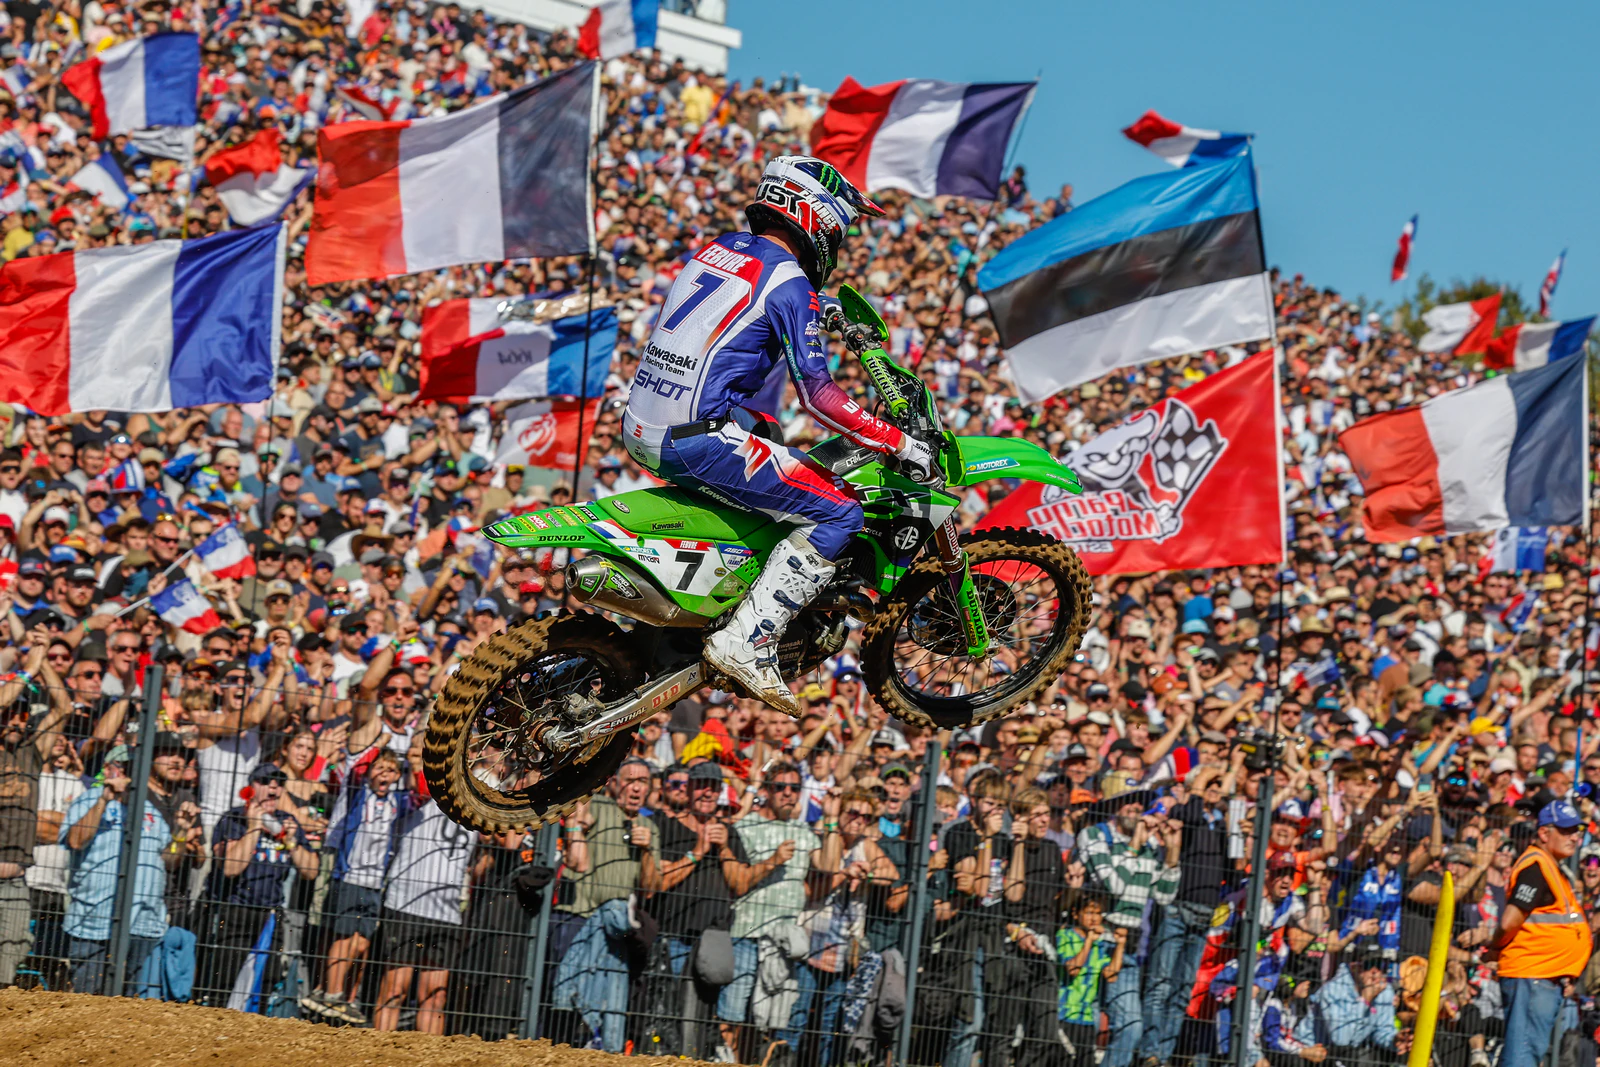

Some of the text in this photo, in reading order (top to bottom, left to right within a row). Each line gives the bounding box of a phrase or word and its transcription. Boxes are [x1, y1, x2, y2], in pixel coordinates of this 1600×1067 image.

[755, 182, 812, 238] UST1
[697, 244, 752, 272] FEBVRE
[660, 268, 730, 335] 7
[645, 355, 685, 377] Racing Team
[646, 340, 698, 372] Kawasaki
[785, 343, 802, 381] MOTOREX
[635, 368, 692, 401] SHOT
[866, 356, 898, 403] RENTHAL
[976, 458, 1008, 471] MOTOREX
[698, 485, 752, 513] Kawasaki
[528, 514, 549, 530] NGK
[652, 521, 684, 531] Kawasaki
[944, 514, 960, 556] SHOWA
[610, 576, 634, 598] CIRCUIT
[614, 573, 630, 587] PRO
[675, 551, 705, 592] 7
[966, 589, 988, 643] DUNLOP
[588, 705, 648, 740] RENTHAL
